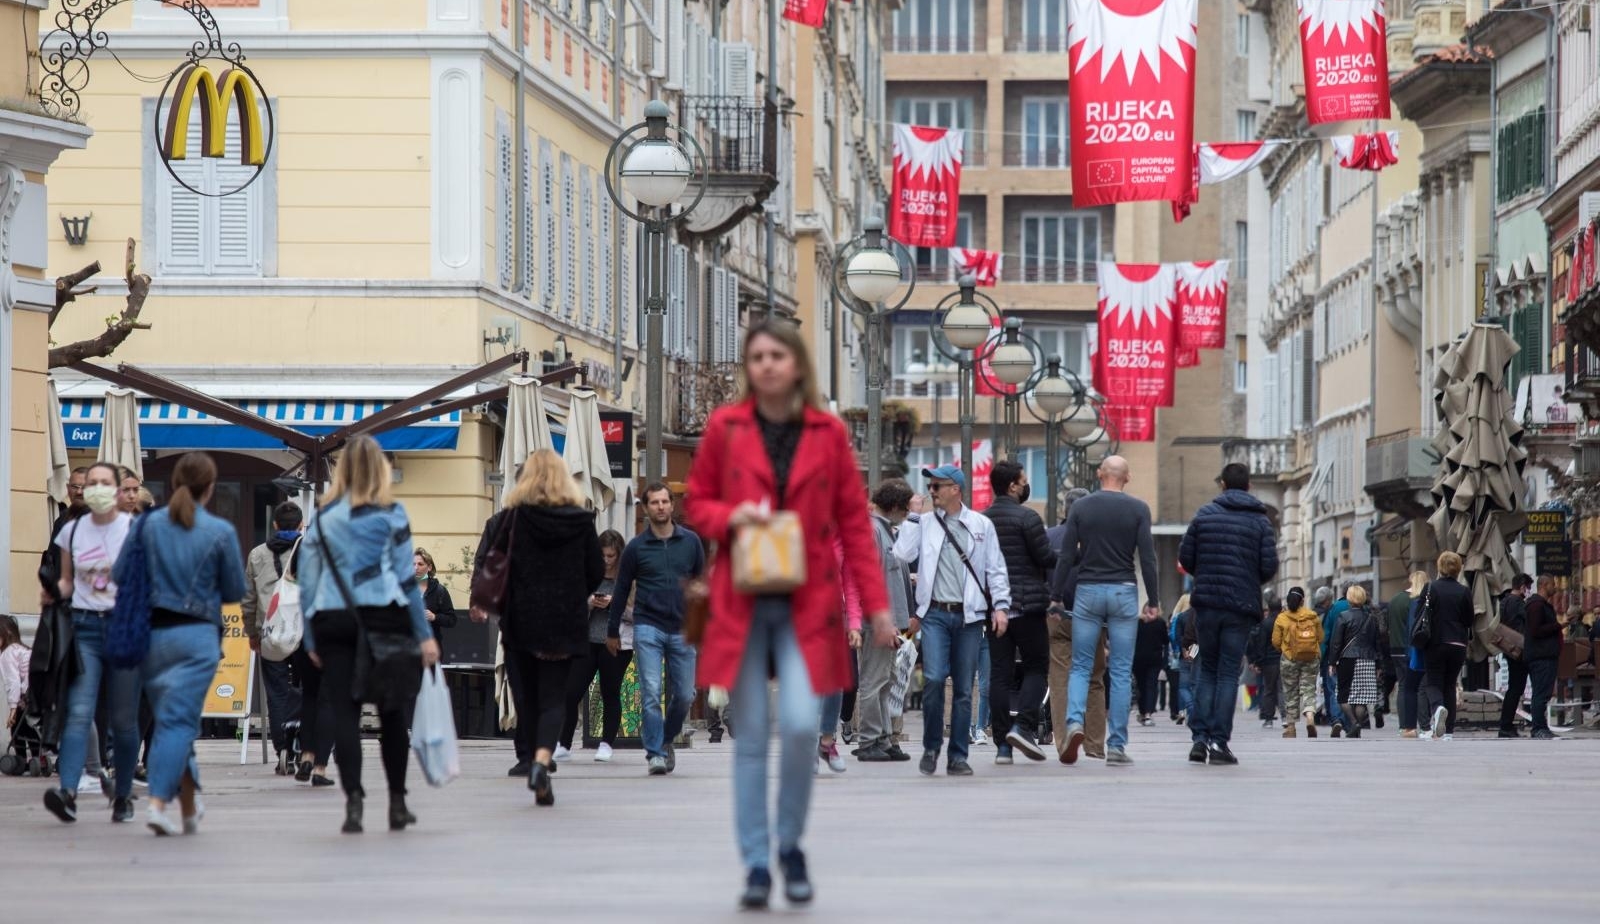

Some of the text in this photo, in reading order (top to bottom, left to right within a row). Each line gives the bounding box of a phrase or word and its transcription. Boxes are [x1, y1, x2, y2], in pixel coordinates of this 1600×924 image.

[1315, 53, 1376, 72] RIJEKA
[1316, 69, 1377, 87] 2020.eu
[1086, 100, 1175, 122] RIJEKA
[1085, 121, 1175, 145] 2020.eu
[1131, 157, 1175, 166] EUROPEAN
[1131, 166, 1175, 174] CAPITAL OF
[1131, 175, 1167, 184] CULTURE
[902, 189, 948, 204] RIJEKA
[1182, 304, 1220, 316] RIJEKA
[1108, 339, 1165, 354] RIJEKA
[1107, 354, 1165, 369] 2020.eu
[72, 427, 97, 441] bar
